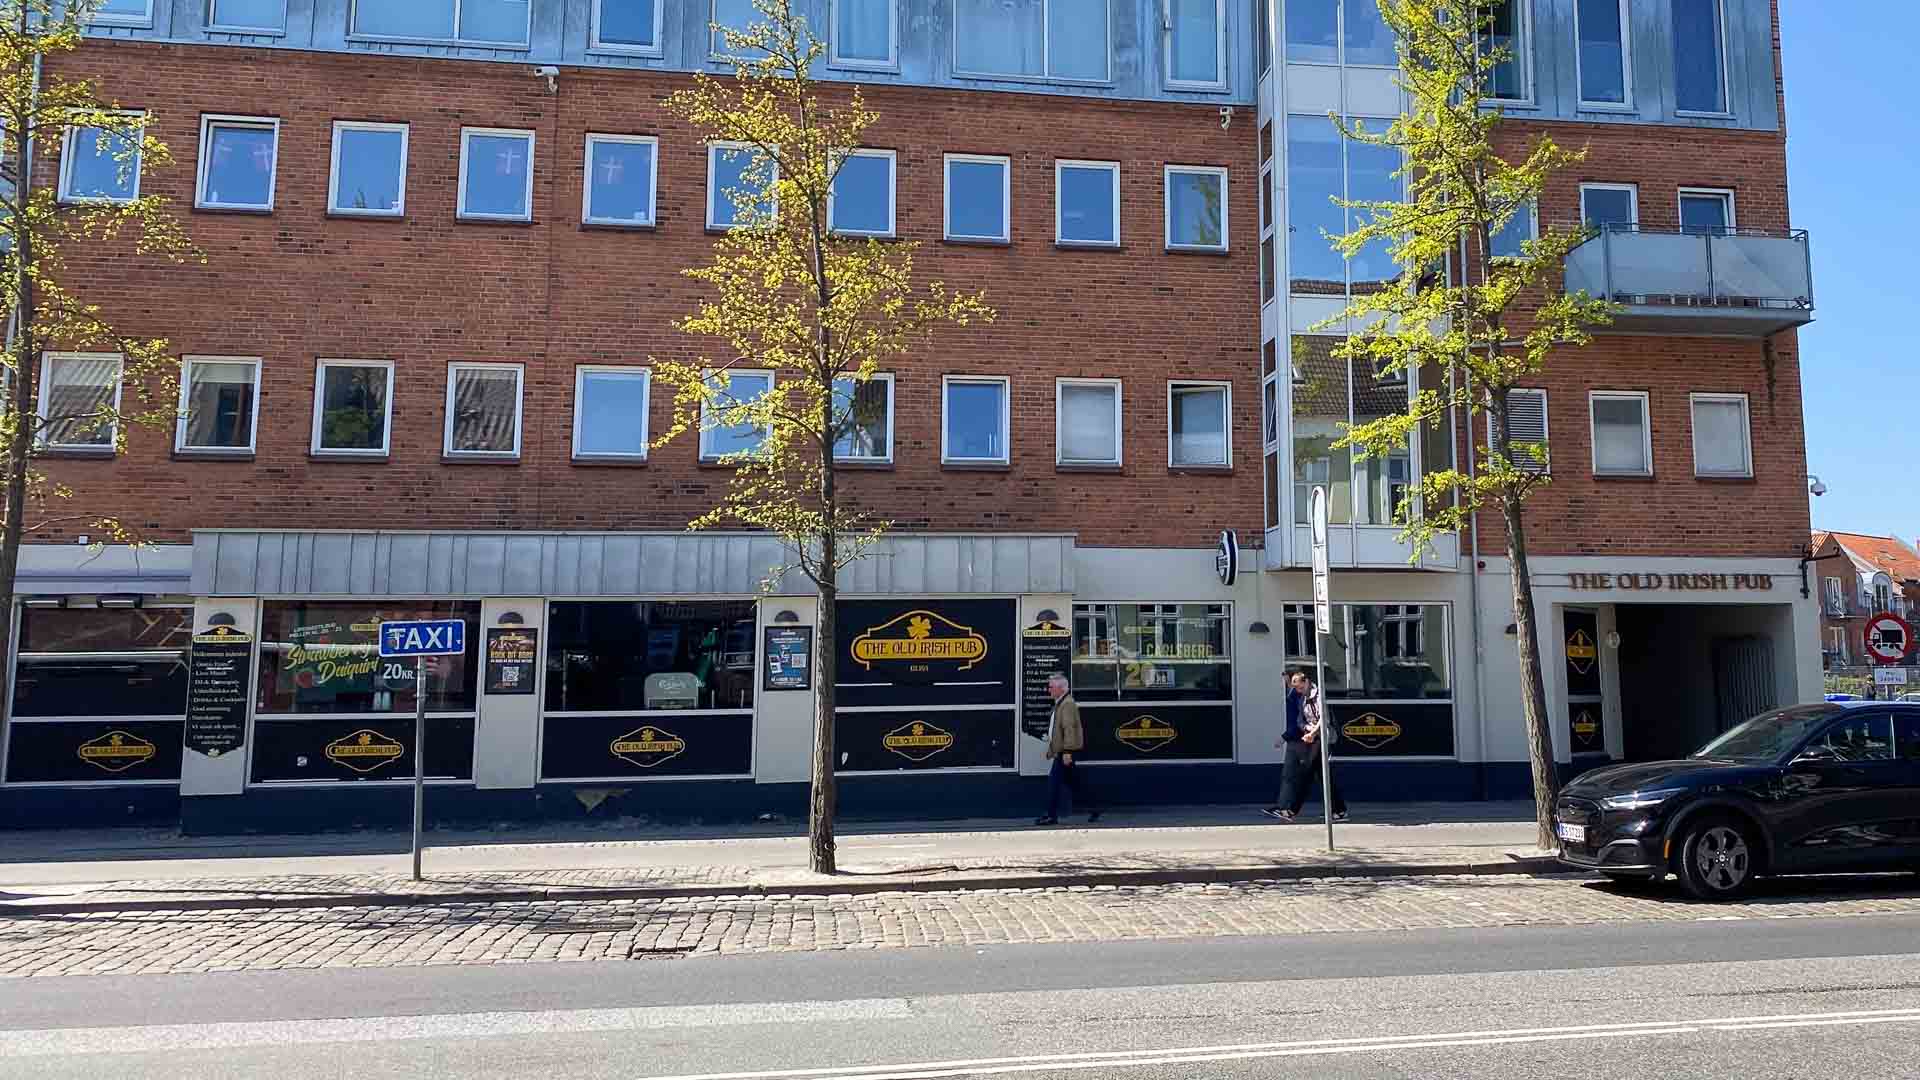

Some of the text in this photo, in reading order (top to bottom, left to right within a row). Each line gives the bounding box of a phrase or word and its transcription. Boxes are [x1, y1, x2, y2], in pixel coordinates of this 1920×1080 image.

[1568, 572, 1773, 591] THE OLD IRISH PUB
[387, 626, 453, 650] TAXI
[283, 640, 368, 671] Strawberry
[863, 641, 978, 657] THE OLD IRISH PUB
[316, 656, 380, 684] Daiquiri
[383, 663, 402, 680] 20
